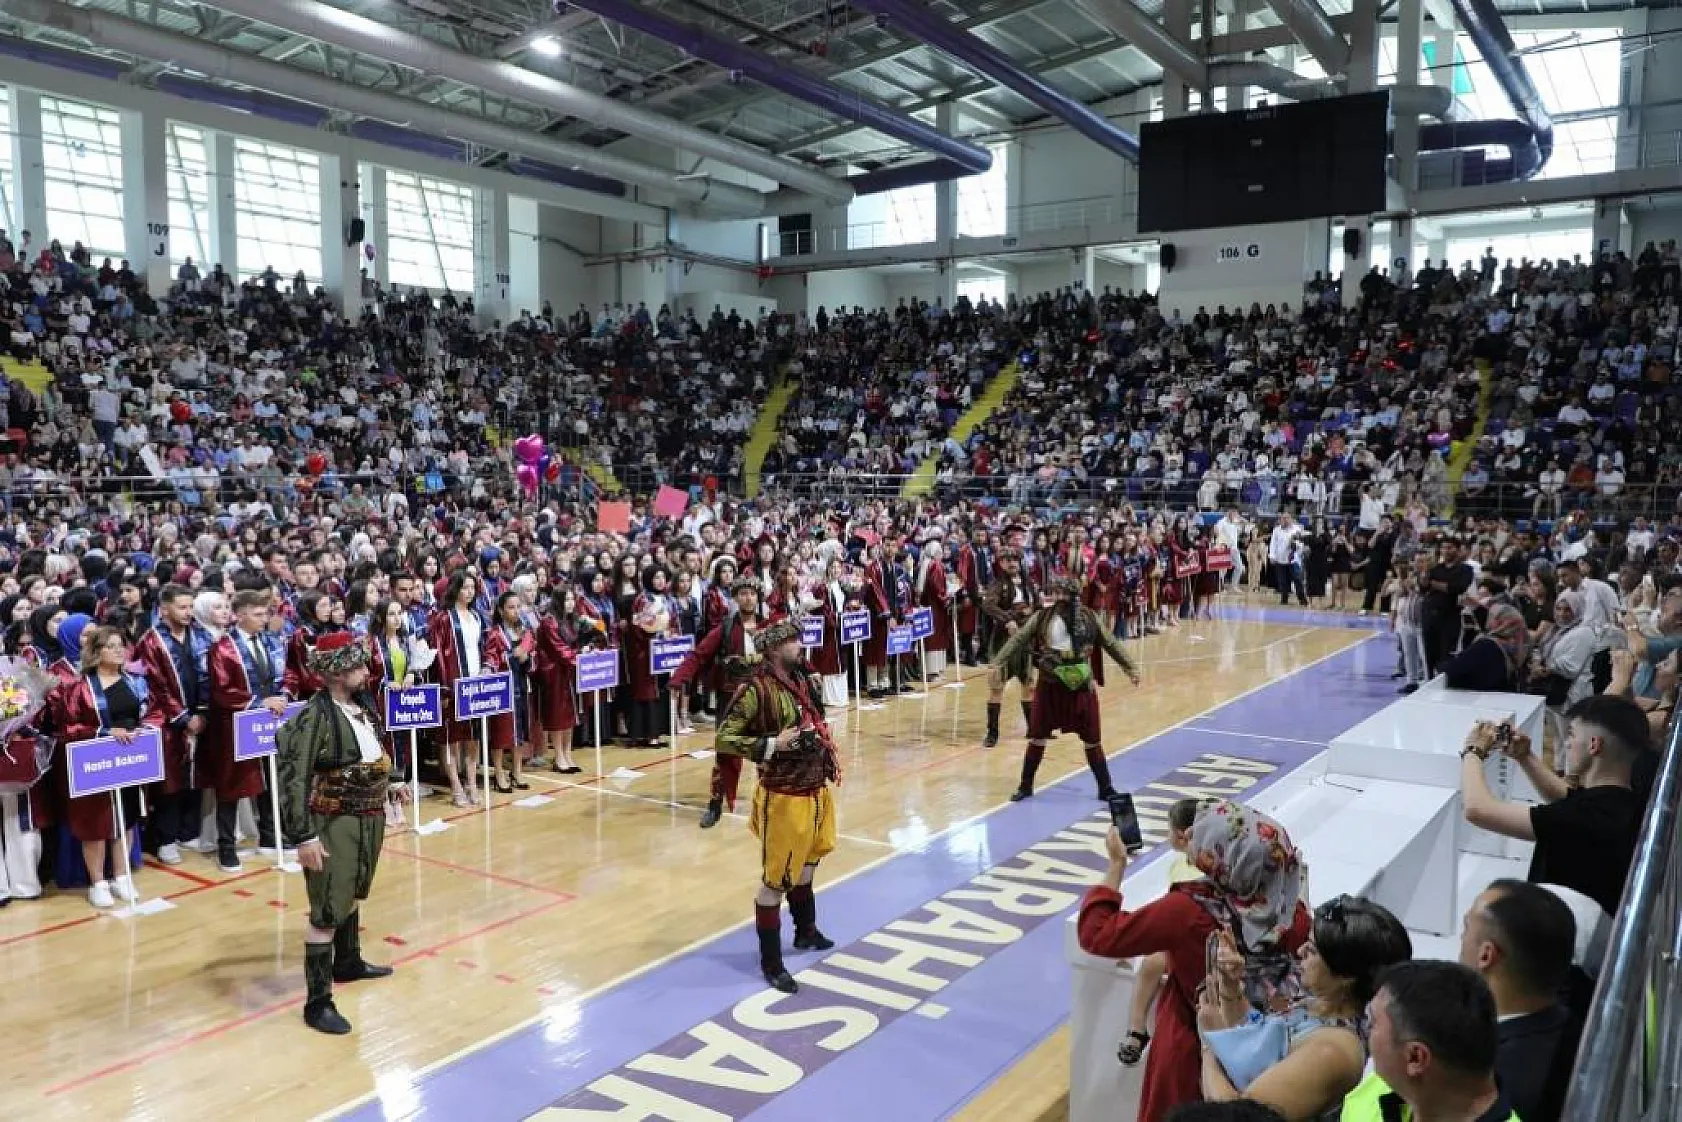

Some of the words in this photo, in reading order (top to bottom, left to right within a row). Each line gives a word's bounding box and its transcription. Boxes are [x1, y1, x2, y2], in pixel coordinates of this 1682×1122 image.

[153, 242, 165, 256] J
[1220, 246, 1240, 259] 106
[1247, 244, 1259, 258] G
[83, 758, 113, 774] Hasta
[114, 753, 148, 768] Bakımı
